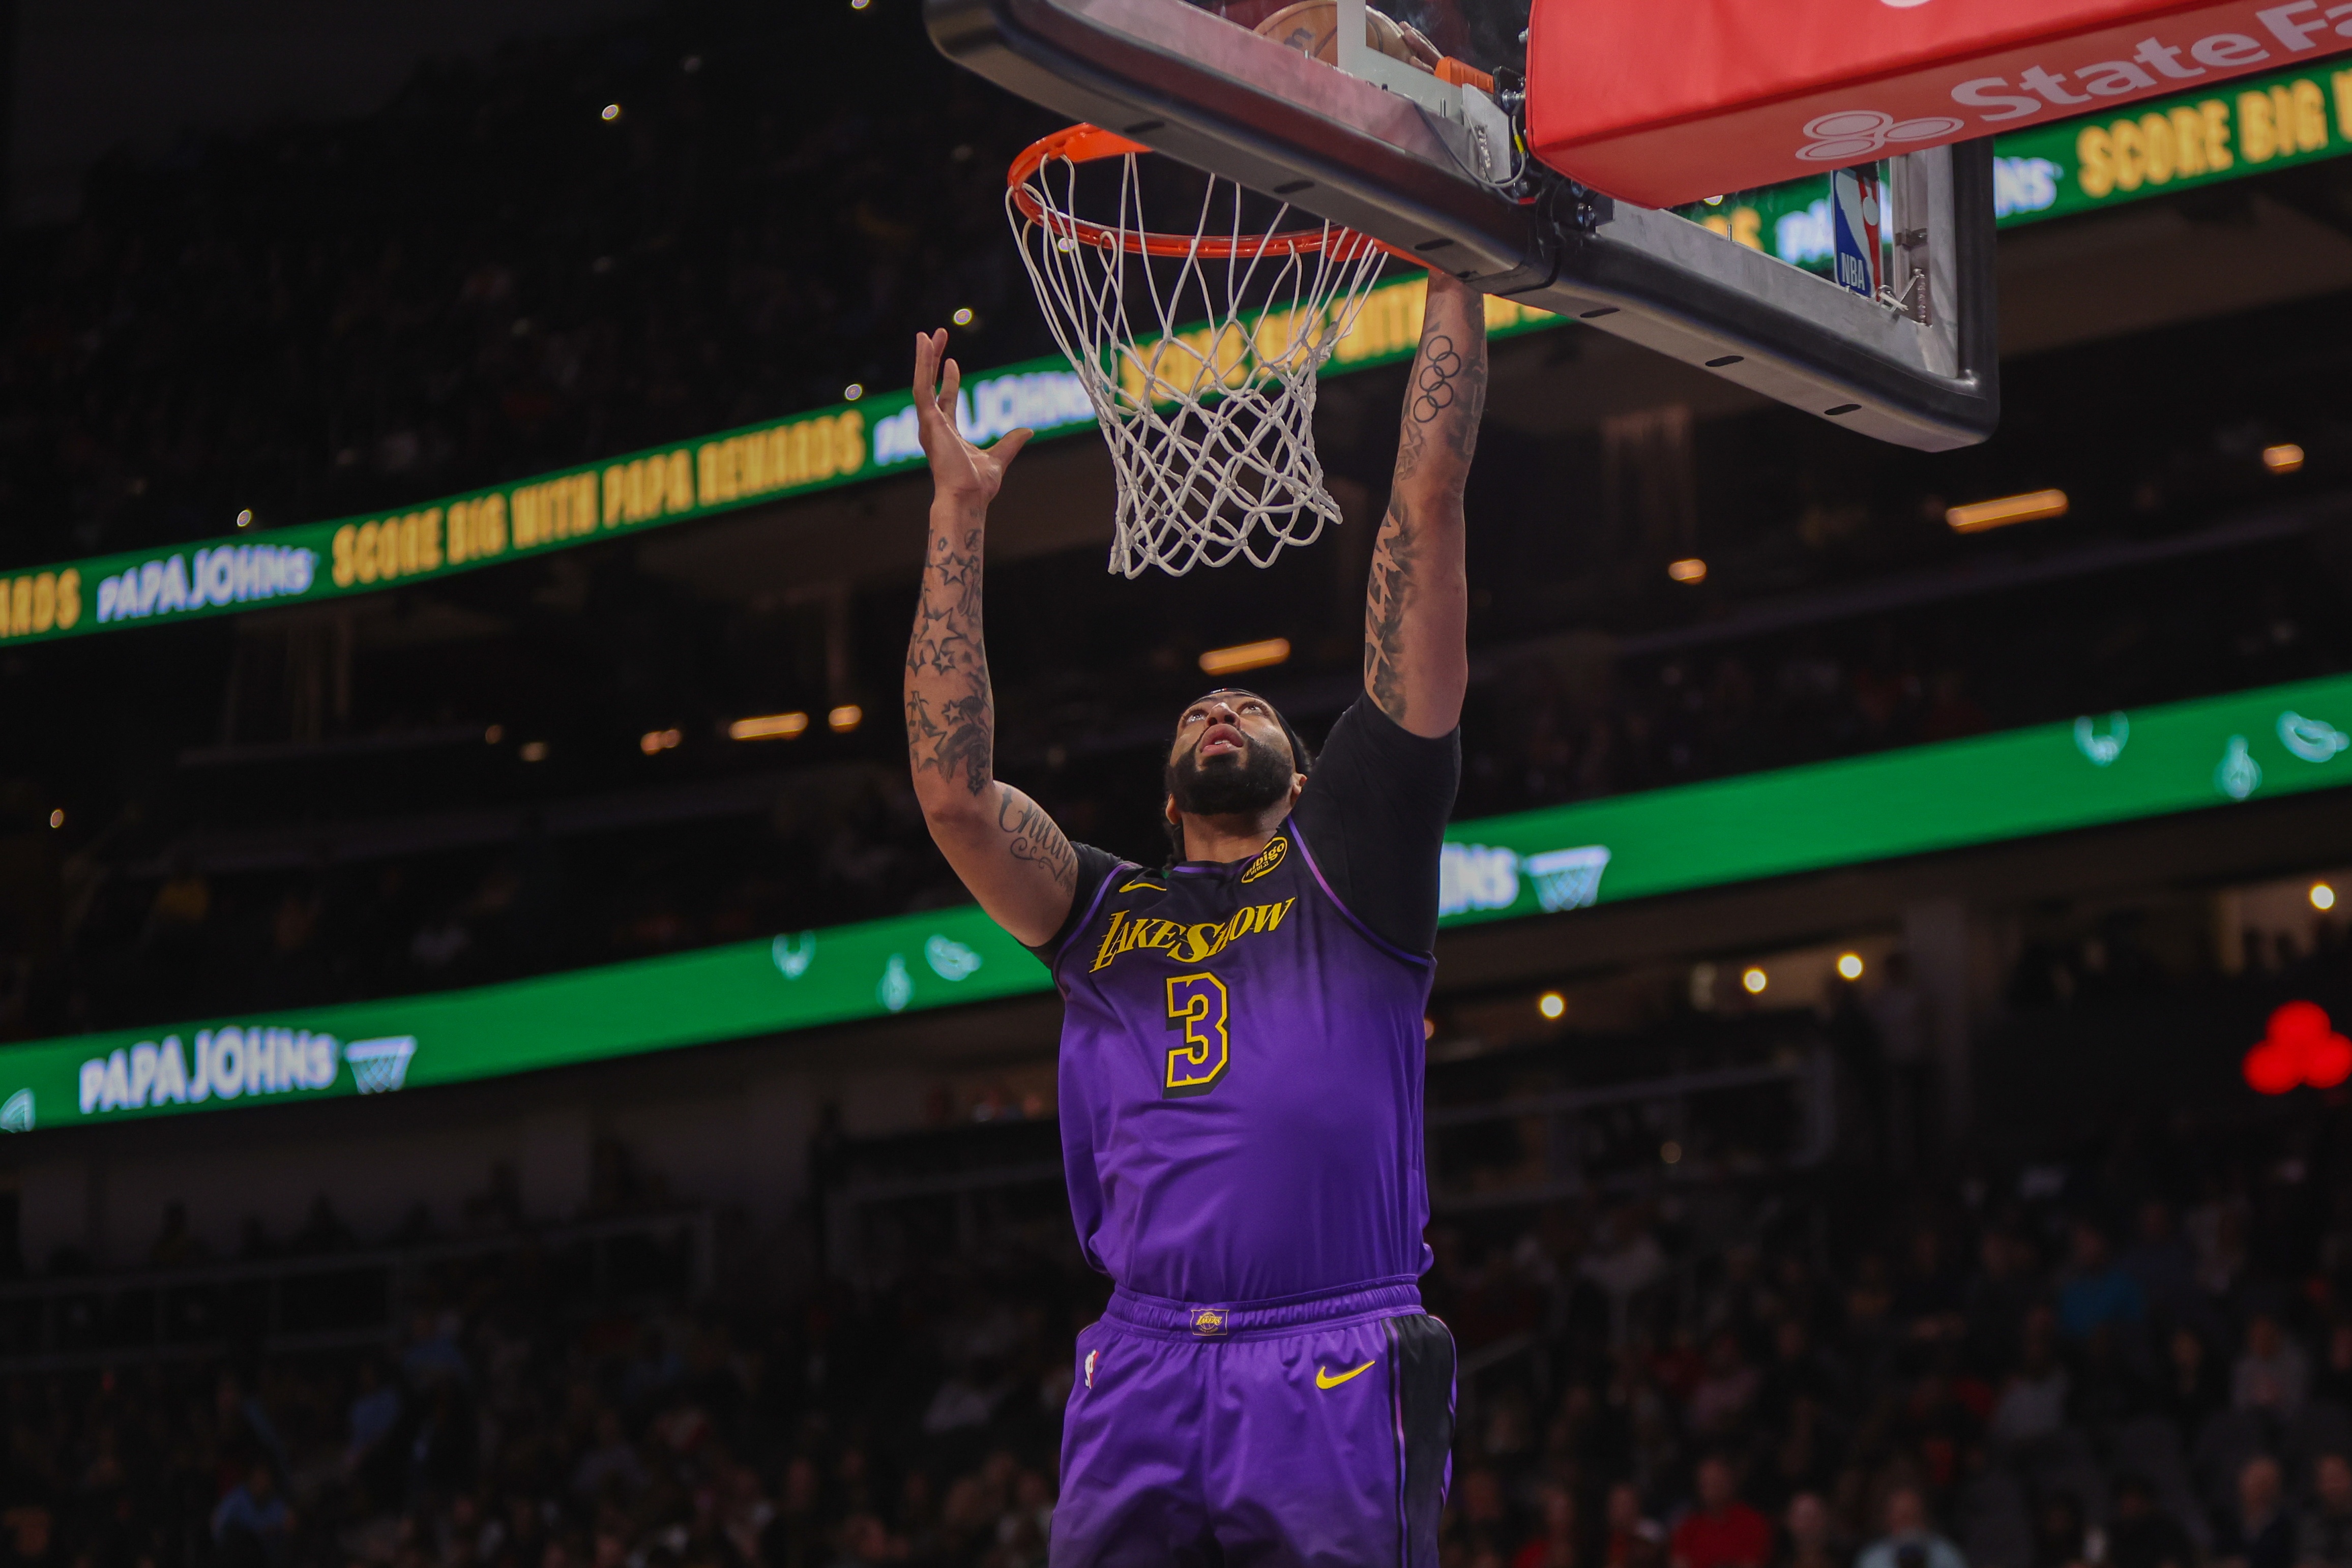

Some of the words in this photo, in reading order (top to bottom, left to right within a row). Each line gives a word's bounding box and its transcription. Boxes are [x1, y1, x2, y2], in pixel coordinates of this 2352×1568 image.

[1950, 33, 2271, 121] State
[2076, 99, 2233, 198] SCORE
[2237, 79, 2329, 164] BIG
[1841, 251, 1866, 291] NBA
[332, 507, 444, 588] SCORE
[447, 491, 508, 566] BIG
[511, 470, 601, 550] WITH
[603, 448, 694, 529] PAPA
[697, 408, 866, 508] REWARDS
[1165, 972, 1229, 1088] 3
